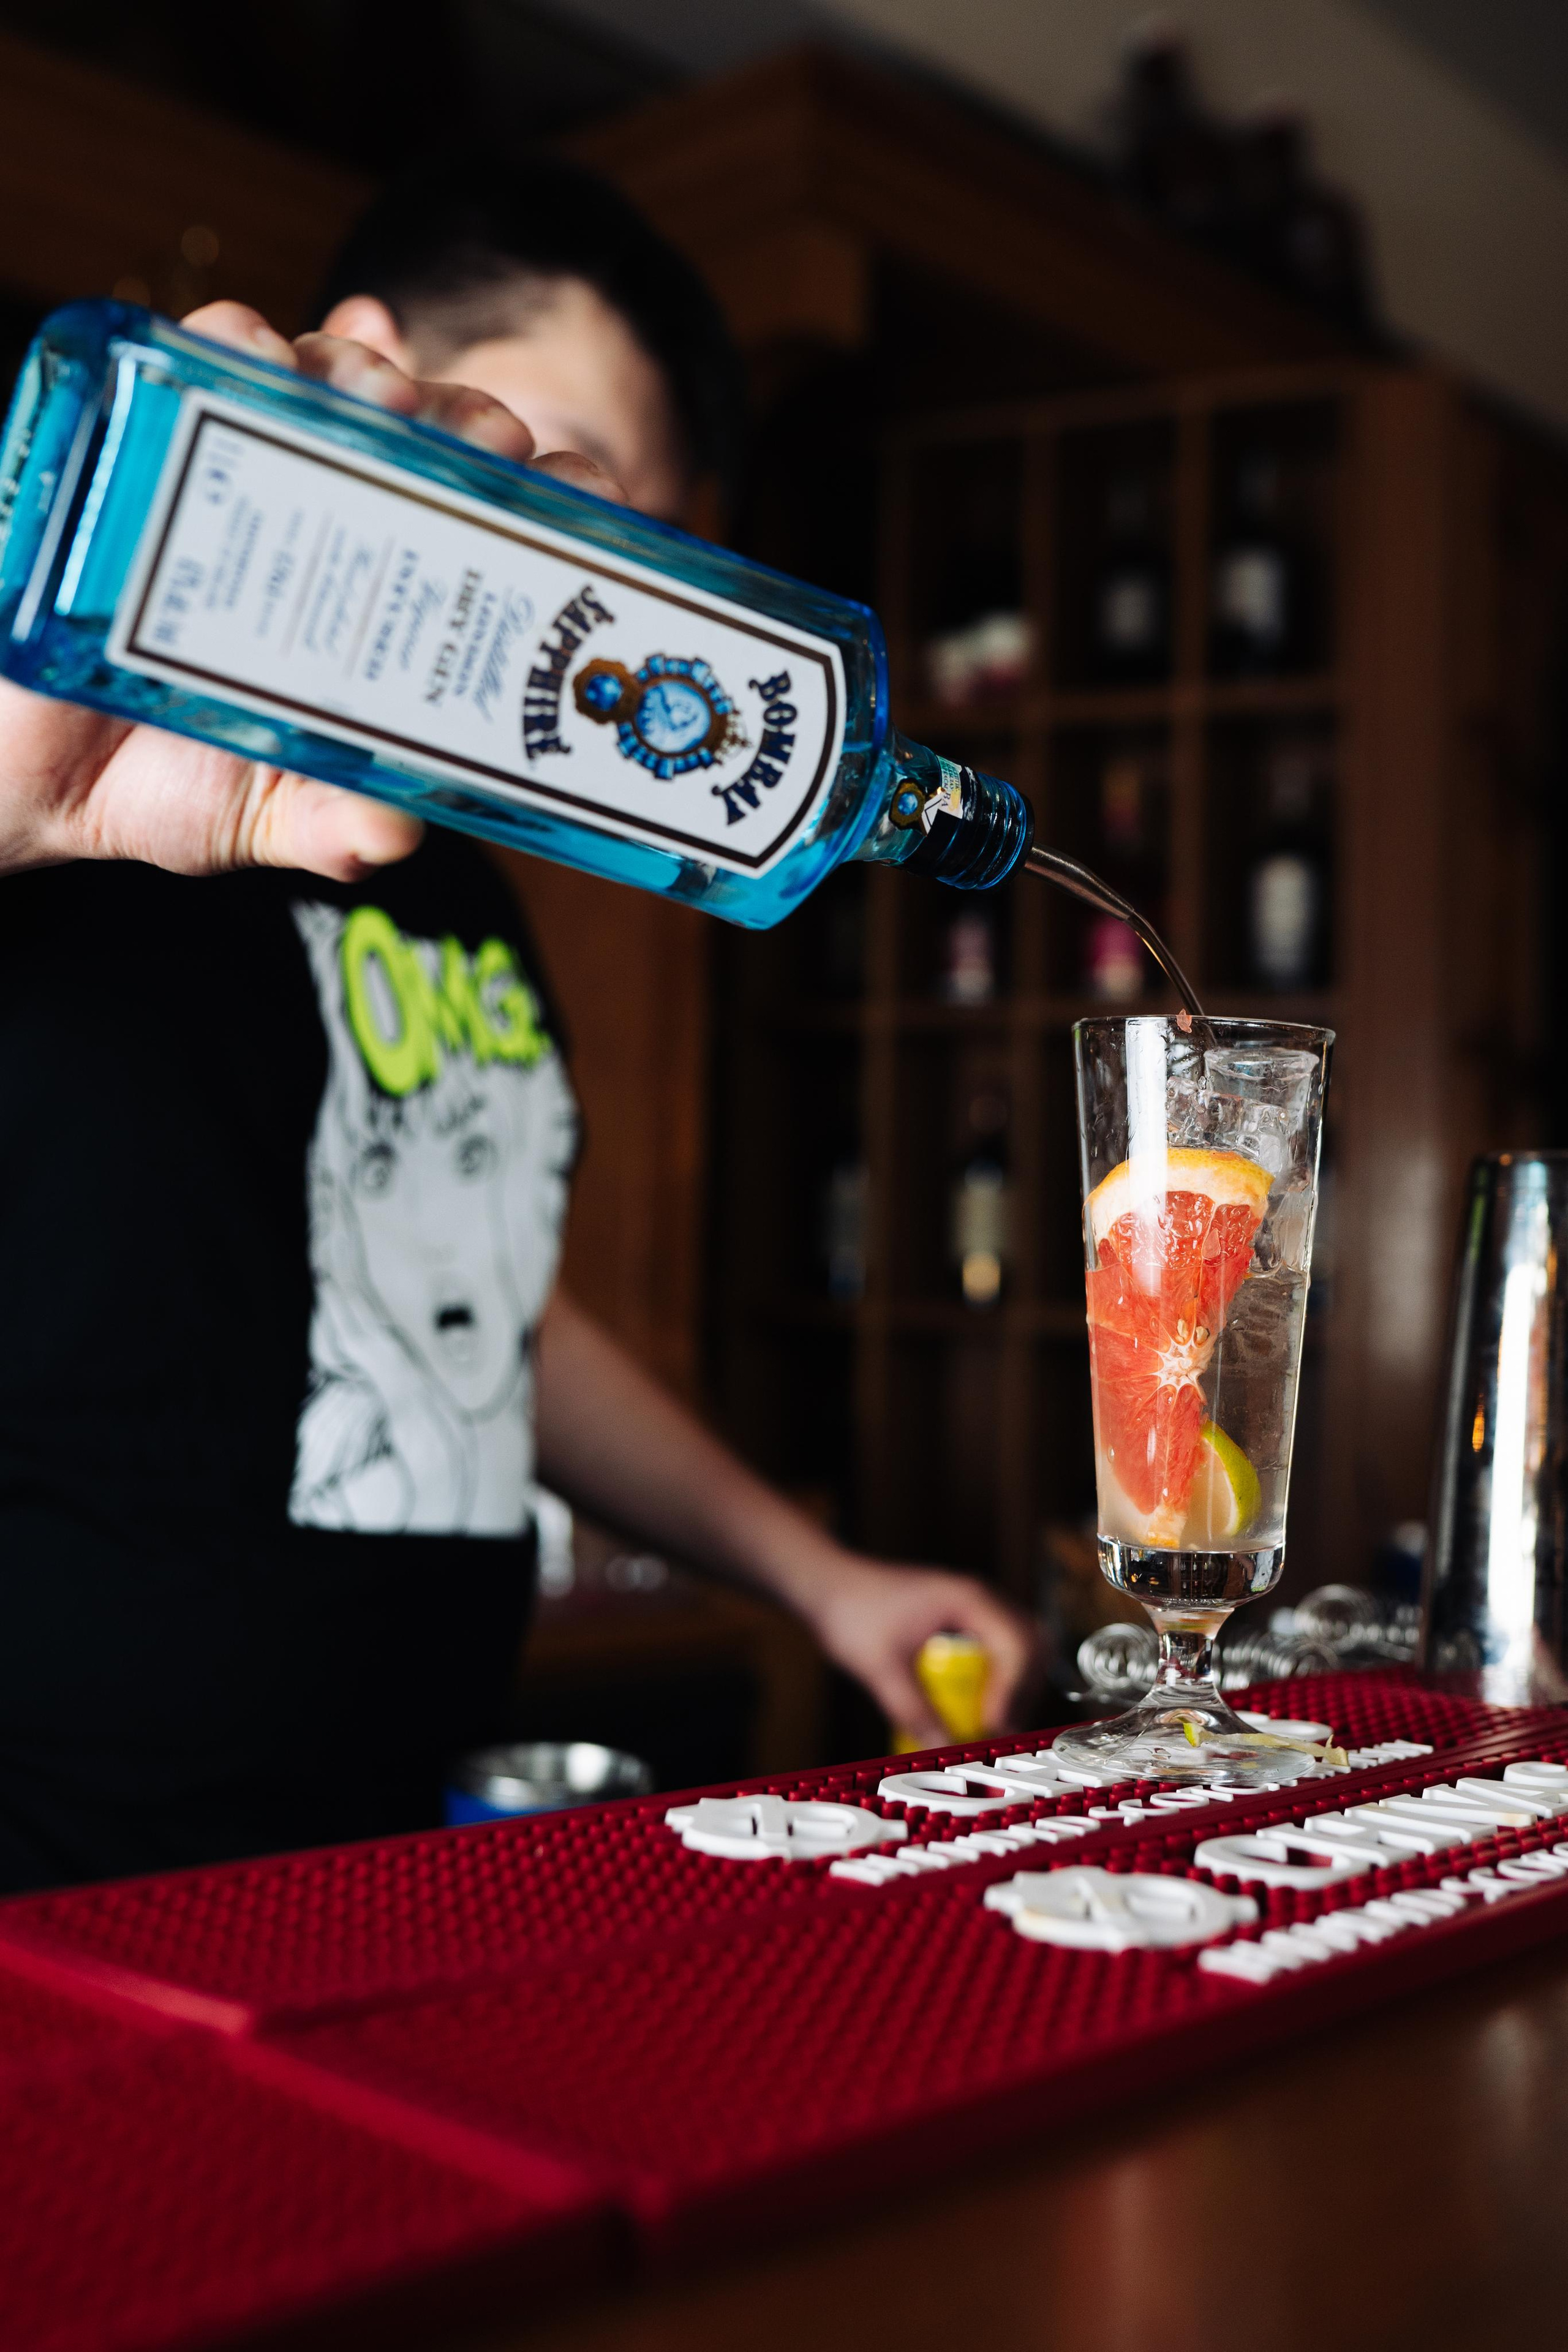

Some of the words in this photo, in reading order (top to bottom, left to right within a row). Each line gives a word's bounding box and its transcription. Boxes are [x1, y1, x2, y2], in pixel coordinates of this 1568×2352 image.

[449, 568, 483, 630] DRY
[425, 643, 457, 706] GIN
[522, 586, 615, 761] SAPPHIRE
[711, 670, 797, 825] BOMBAY
[1440, 1842, 1568, 1904] SCOT
